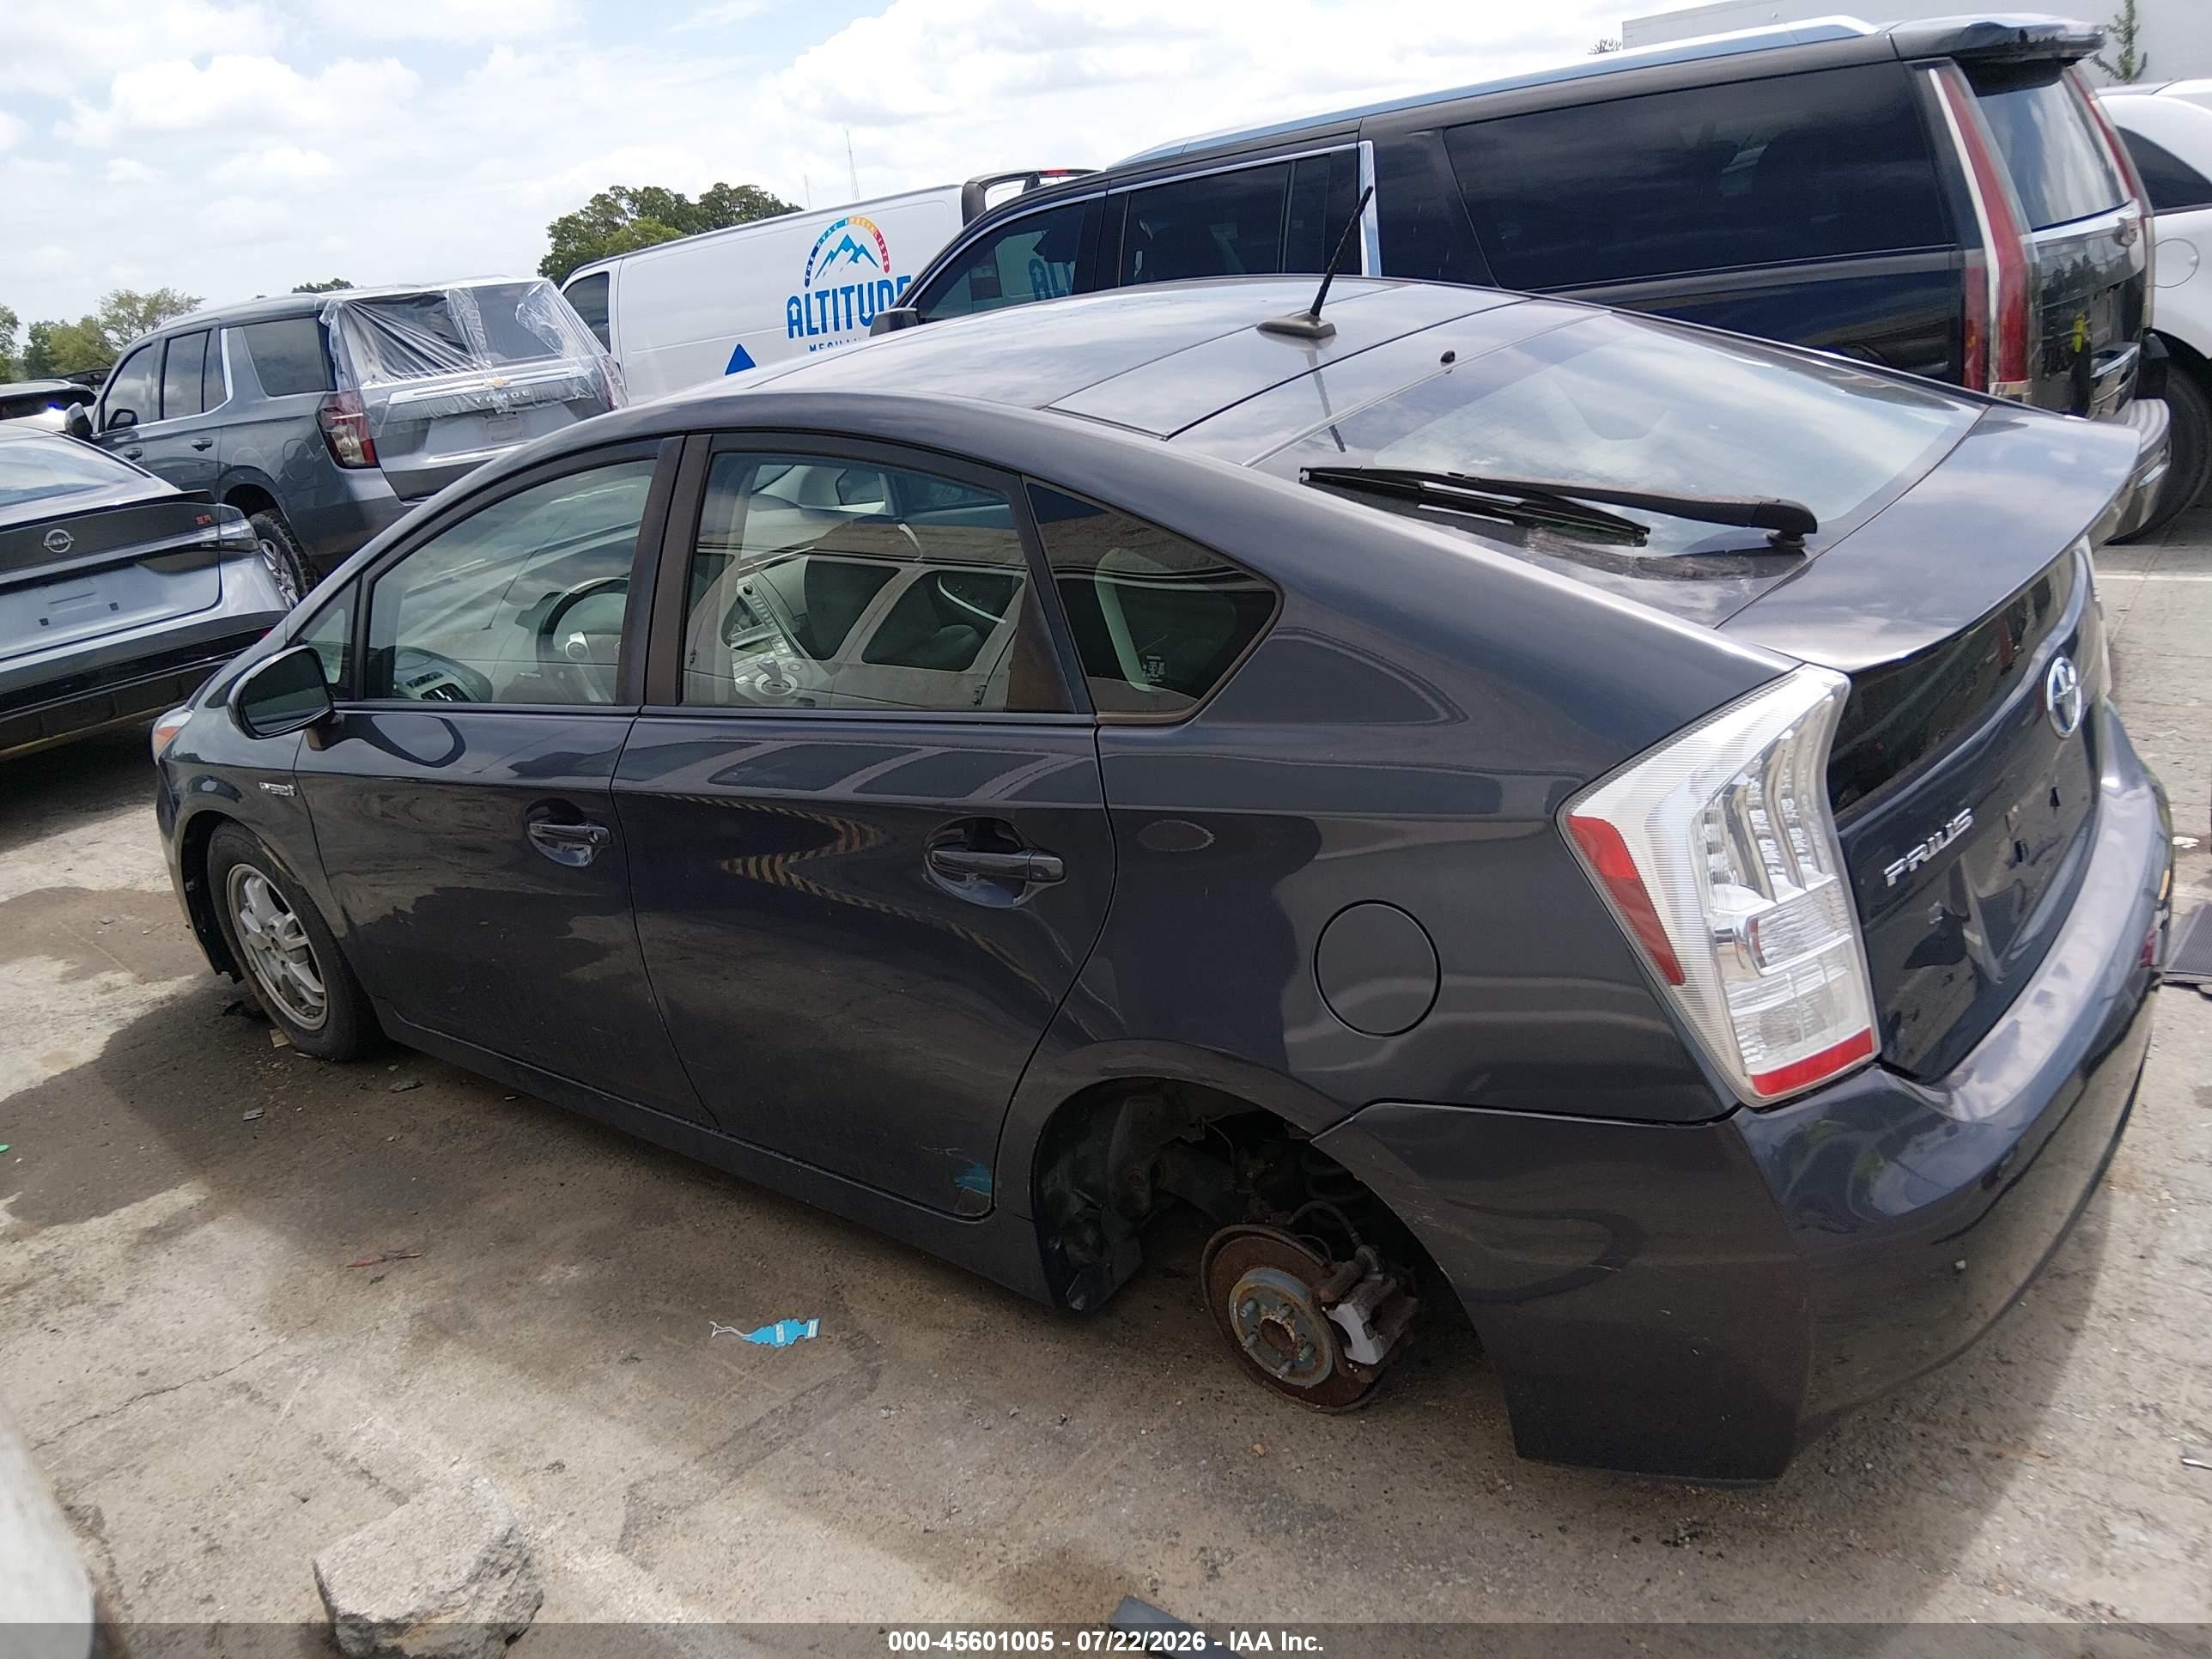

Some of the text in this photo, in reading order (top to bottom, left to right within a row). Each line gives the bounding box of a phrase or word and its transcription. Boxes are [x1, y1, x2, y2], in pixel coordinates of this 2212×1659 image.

[805, 255, 815, 279] THE
[817, 223, 839, 249] HVAC
[1884, 808, 1973, 887] PRIUS
